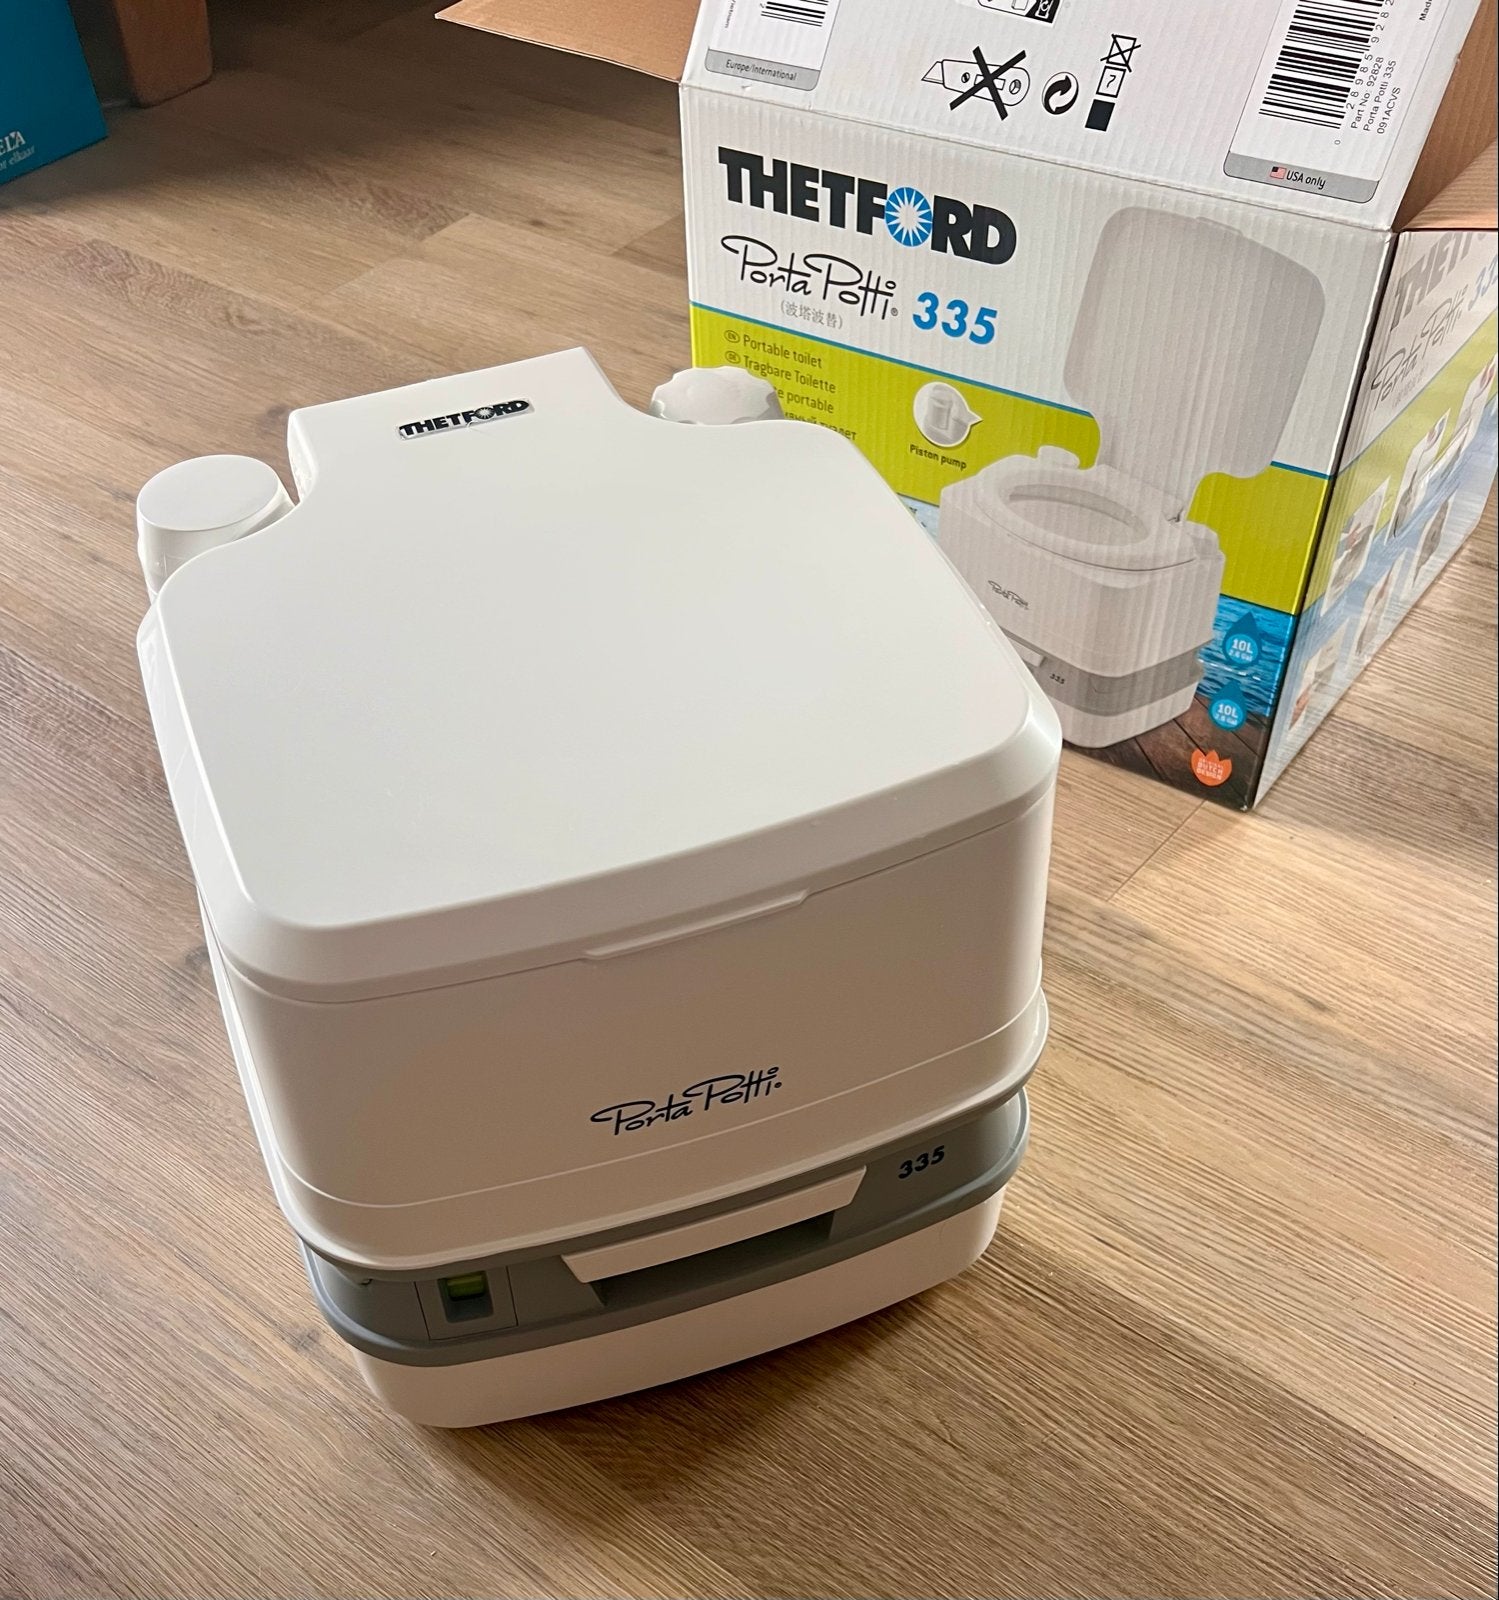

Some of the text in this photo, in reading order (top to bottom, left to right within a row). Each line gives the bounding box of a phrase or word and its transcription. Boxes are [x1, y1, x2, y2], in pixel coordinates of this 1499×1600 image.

[725, 59, 798, 81] Europe/International
[1350, 109, 1364, 129] Part
[1366, 57, 1384, 87] 92828
[1363, 60, 1397, 131] Porta Potti 335
[1377, 87, 1401, 134] 091ACVS
[1286, 170, 1326, 190] USA only
[718, 146, 1017, 265] THETFORD
[720, 235, 998, 345] Porta Potti 335
[743, 334, 791, 359] Portable
[793, 350, 823, 369] toilet
[743, 355, 792, 380] Tragbare
[794, 369, 837, 394] Toilette
[399, 400, 530, 436] THETFORD
[786, 392, 835, 414] portable
[910, 444, 967, 472] Piston pump
[1231, 638, 1253, 654] 10L
[1217, 703, 1238, 719] 10L
[590, 1067, 780, 1136] Porta Potti
[898, 1145, 945, 1179] 335
